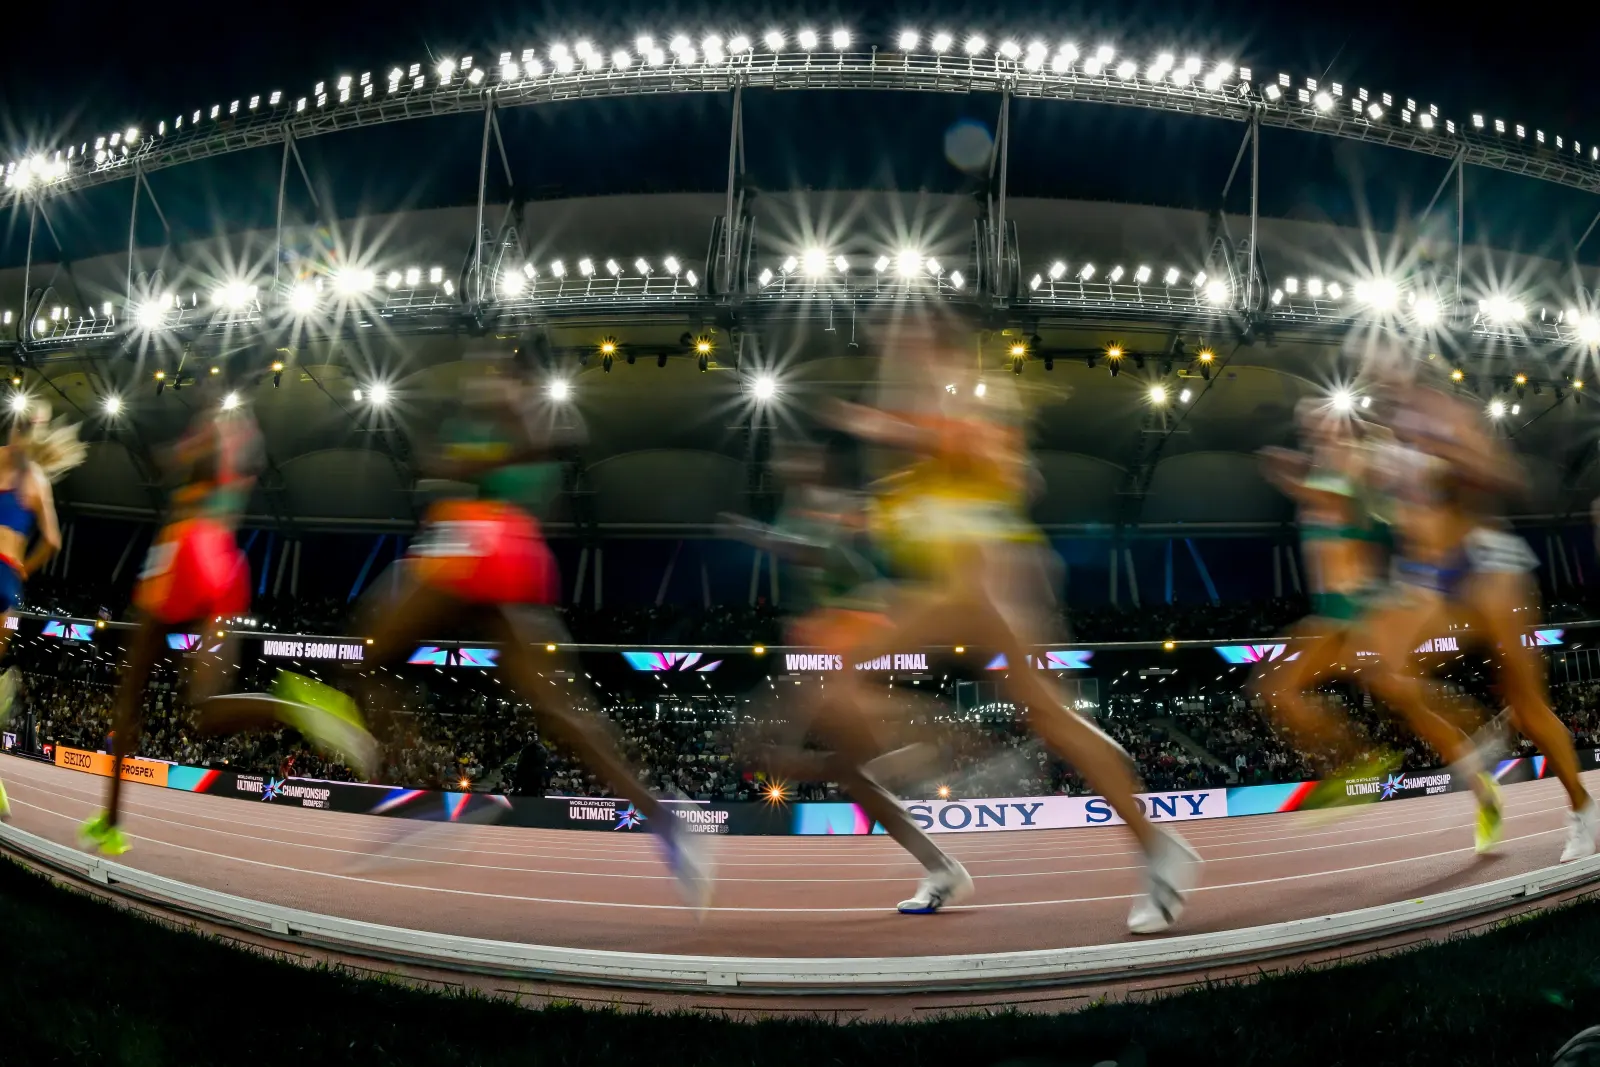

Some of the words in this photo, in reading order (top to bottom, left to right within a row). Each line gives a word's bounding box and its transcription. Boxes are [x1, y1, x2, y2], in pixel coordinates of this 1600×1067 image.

[264, 640, 303, 657] WOMEN'S
[305, 643, 337, 659] 5000M
[338, 645, 364, 660] FINAL
[1434, 637, 1459, 652] FINAL
[786, 654, 843, 671] WOMEN'S
[894, 654, 928, 670] FINAL
[64, 752, 91, 768] SEIKO
[121, 764, 154, 778] PROSPEX
[237, 780, 263, 792] ULTIMATE
[282, 785, 330, 800] CHAMPIONSHIP
[1346, 782, 1380, 796] ULTIMATE
[1403, 774, 1451, 789] CHAMPIONSHIP
[569, 807, 616, 821] ULTIMATE
[671, 810, 729, 824] PIONSHIP
[907, 803, 1043, 830] SONY
